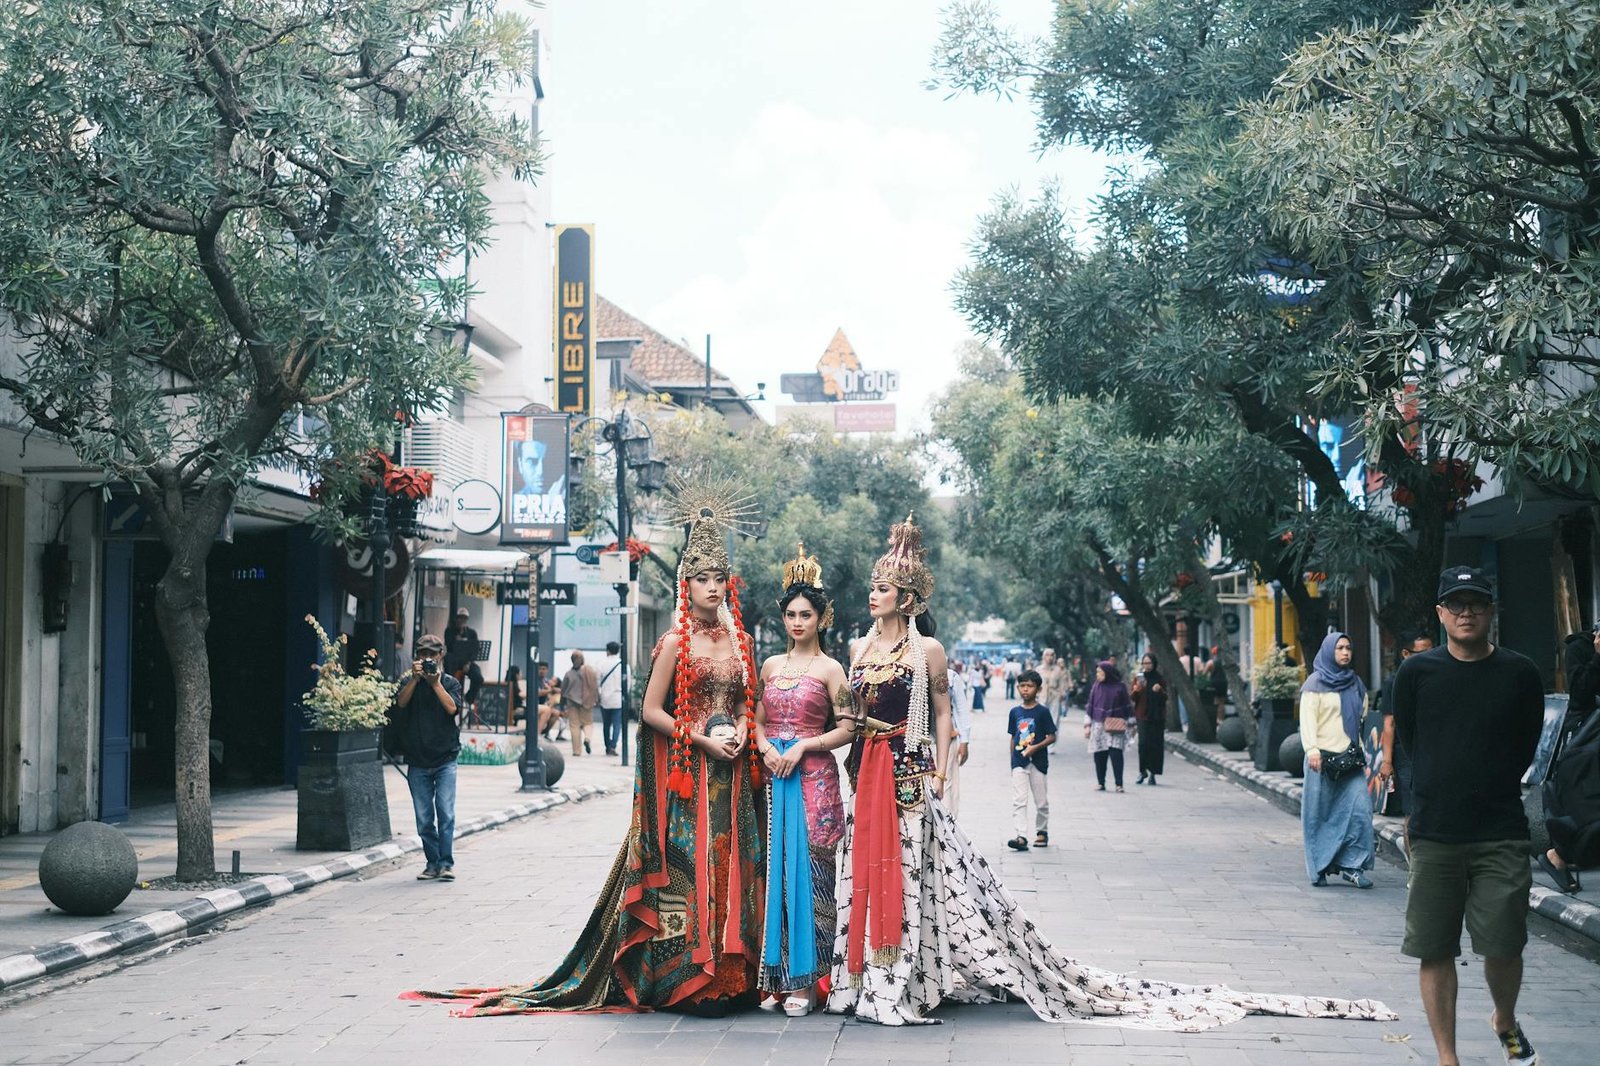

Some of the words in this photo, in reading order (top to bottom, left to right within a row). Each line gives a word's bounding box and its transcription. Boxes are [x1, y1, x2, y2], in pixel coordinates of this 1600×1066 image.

[513, 494, 566, 515] PRIA
[529, 560, 537, 619] BRAGA
[579, 618, 612, 627] ENTER
